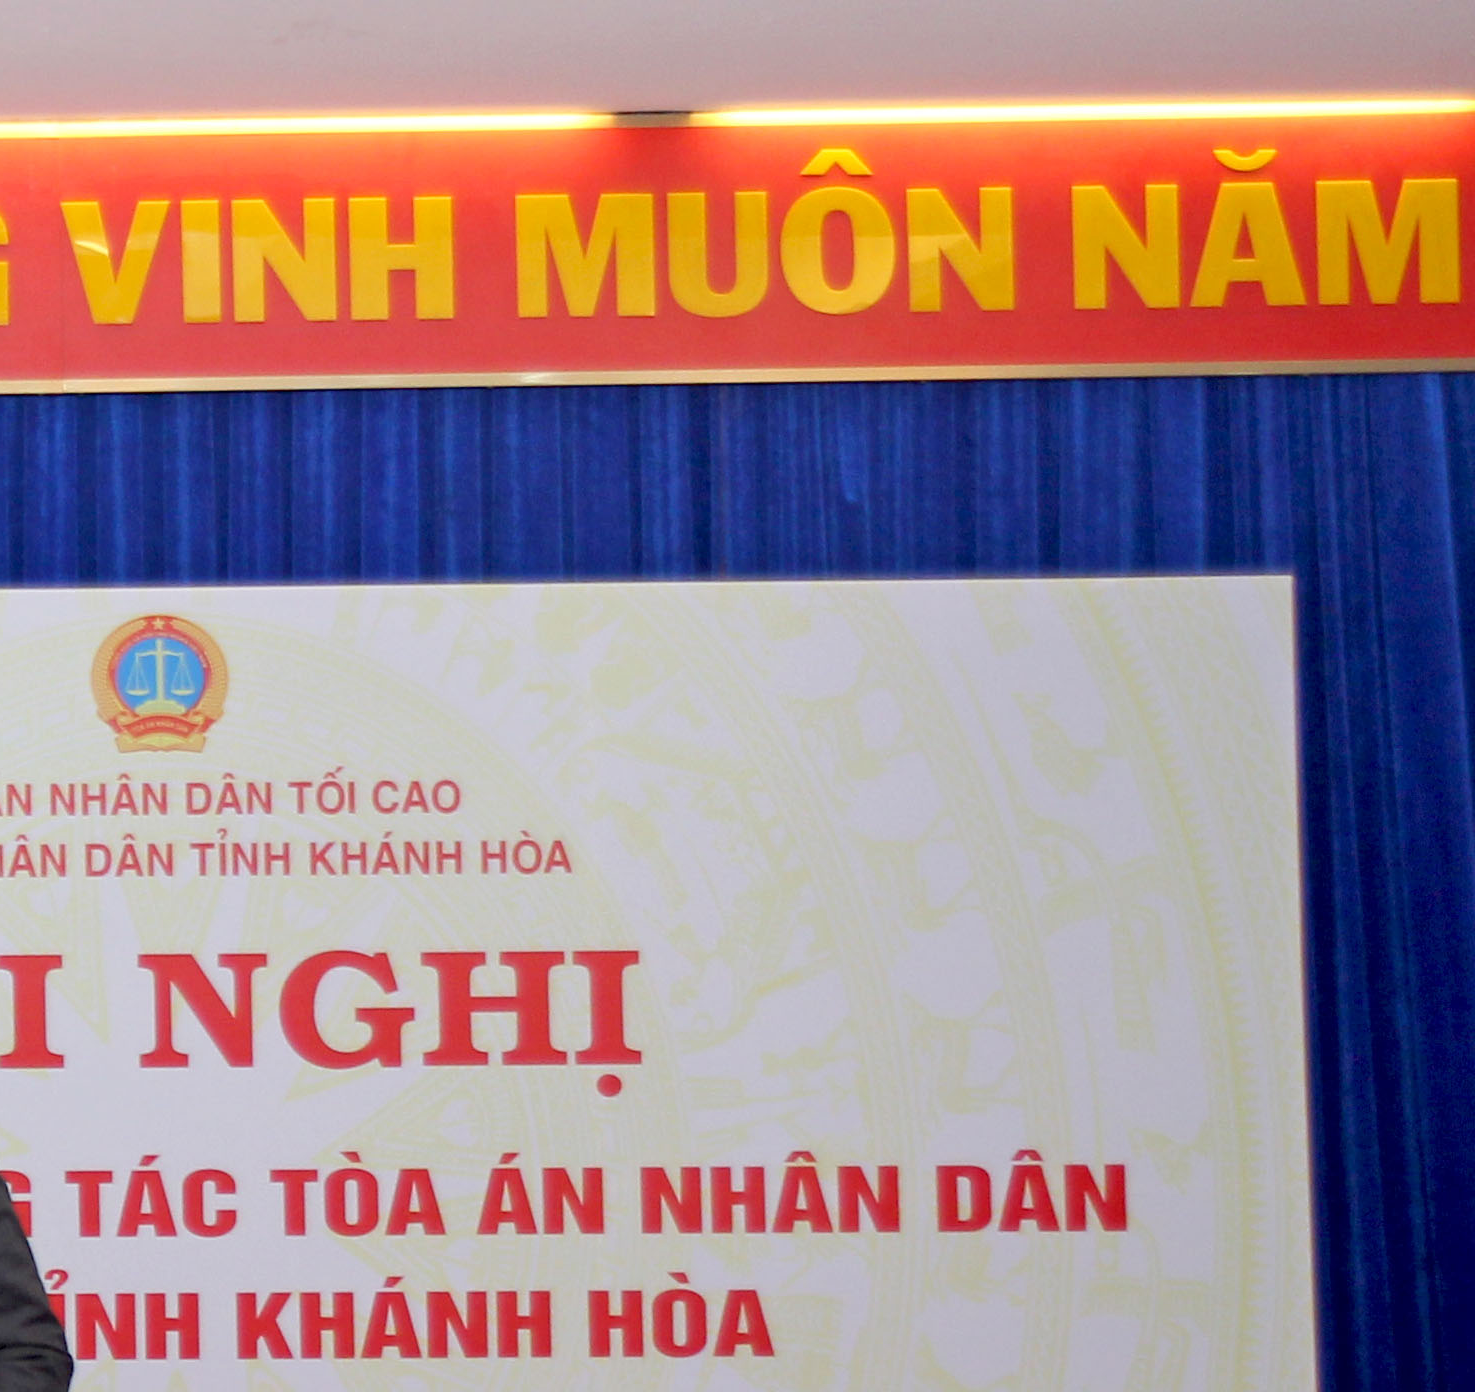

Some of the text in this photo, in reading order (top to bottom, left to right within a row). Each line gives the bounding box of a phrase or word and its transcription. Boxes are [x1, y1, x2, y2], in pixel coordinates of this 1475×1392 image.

[60, 195, 455, 325] VINH
[515, 147, 1016, 319] MUÔN
[1071, 148, 1462, 310] NĂM
[49, 773, 169, 816] NHÂN
[185, 772, 274, 815] DÂN
[288, 765, 357, 815] TỐI
[372, 779, 462, 815] CAO
[84, 832, 175, 877] DÂN
[191, 829, 291, 876] TỈNH
[309, 836, 464, 876] KHÁNH
[481, 829, 573, 875] HÒA
[138, 949, 643, 1098] NGHỊ
[65, 1154, 238, 1238] TÁC
[270, 1151, 447, 1237] TÒA
[478, 1152, 605, 1236] ÁN
[641, 1151, 901, 1235] NHÂN
[937, 1149, 1129, 1233] DÂN
[236, 1276, 553, 1360] KHÁNH
[588, 1272, 776, 1359] HÒA
